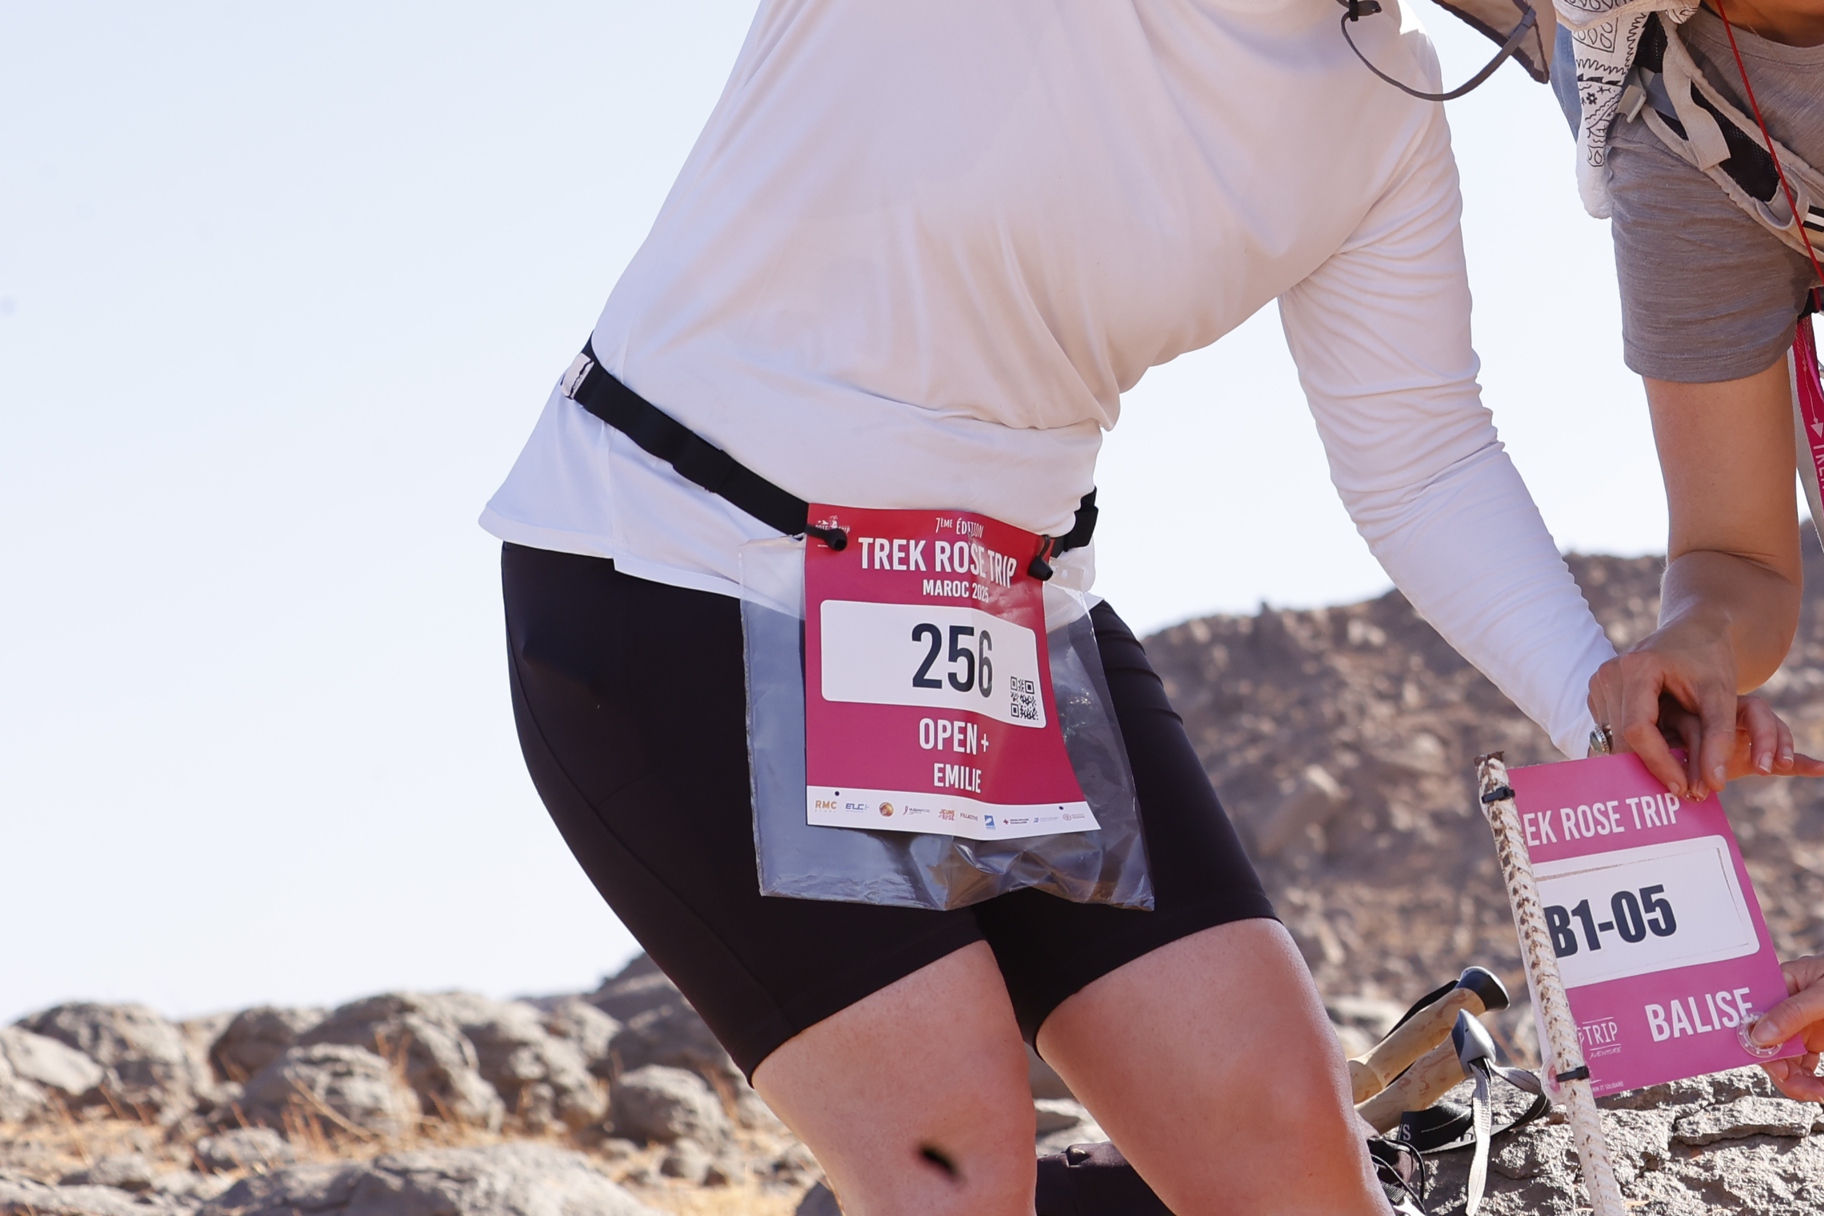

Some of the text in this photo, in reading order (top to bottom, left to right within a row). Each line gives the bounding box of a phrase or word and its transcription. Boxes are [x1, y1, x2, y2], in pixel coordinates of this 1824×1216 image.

[956, 517, 984, 539] ÉDITION
[858, 537, 1017, 589] TREK ROSE TRIP
[923, 579, 989, 603] MAROC 2025
[911, 622, 993, 698] 256
[919, 718, 989, 755] OPEN +
[933, 763, 982, 793] EMILIE
[815, 800, 837, 810] RMC
[1522, 792, 1681, 847] EK ROSE TRIP
[1543, 884, 1677, 958] B1-05
[1644, 987, 1759, 1042] BALISE
[1583, 1022, 1618, 1045] TRIP
